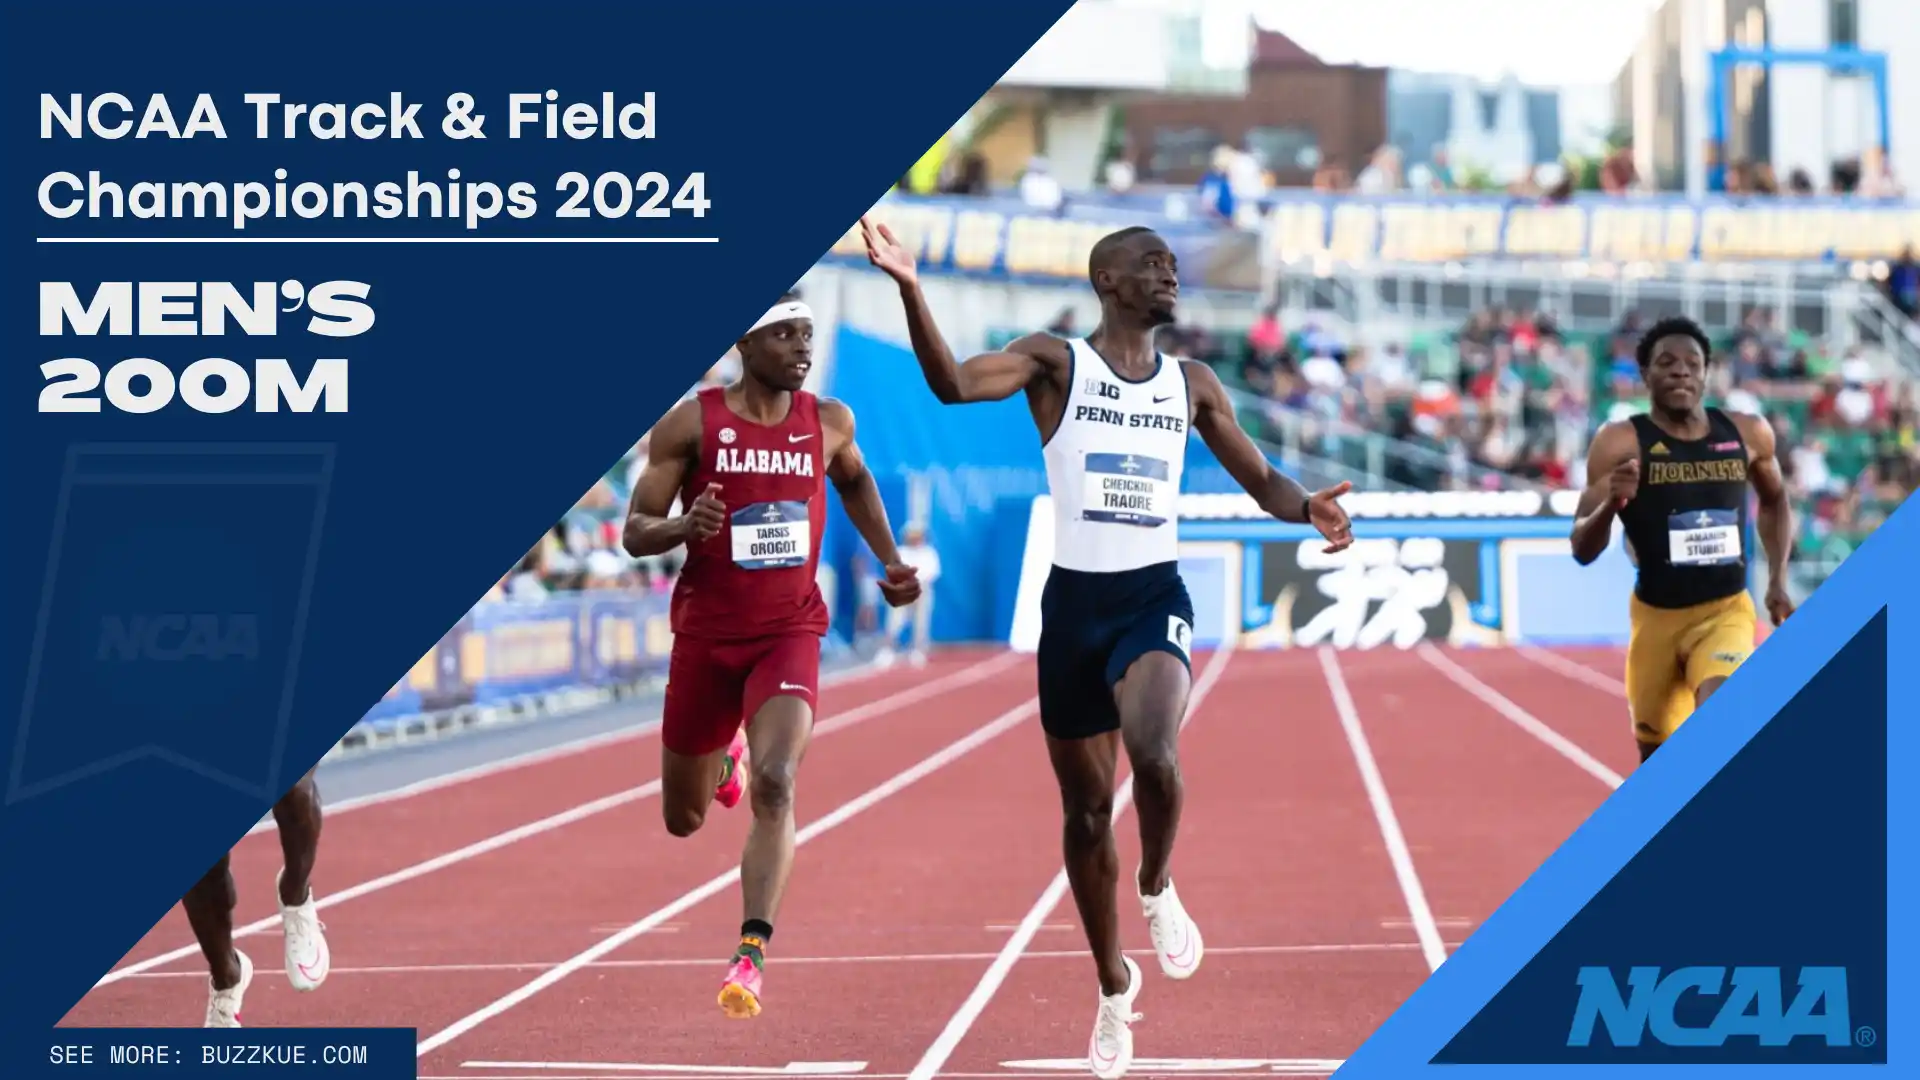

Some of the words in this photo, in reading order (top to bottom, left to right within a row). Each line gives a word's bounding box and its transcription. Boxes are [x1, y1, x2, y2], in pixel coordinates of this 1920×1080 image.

[1075, 405, 1125, 426] PENN
[1129, 414, 1184, 433] STATE
[715, 448, 815, 478] ALABAMA
[1648, 459, 1747, 485] HORNETS
[1103, 493, 1154, 511] TRAORE
[756, 526, 790, 539] TARSIS
[750, 540, 797, 556] OROGOT
